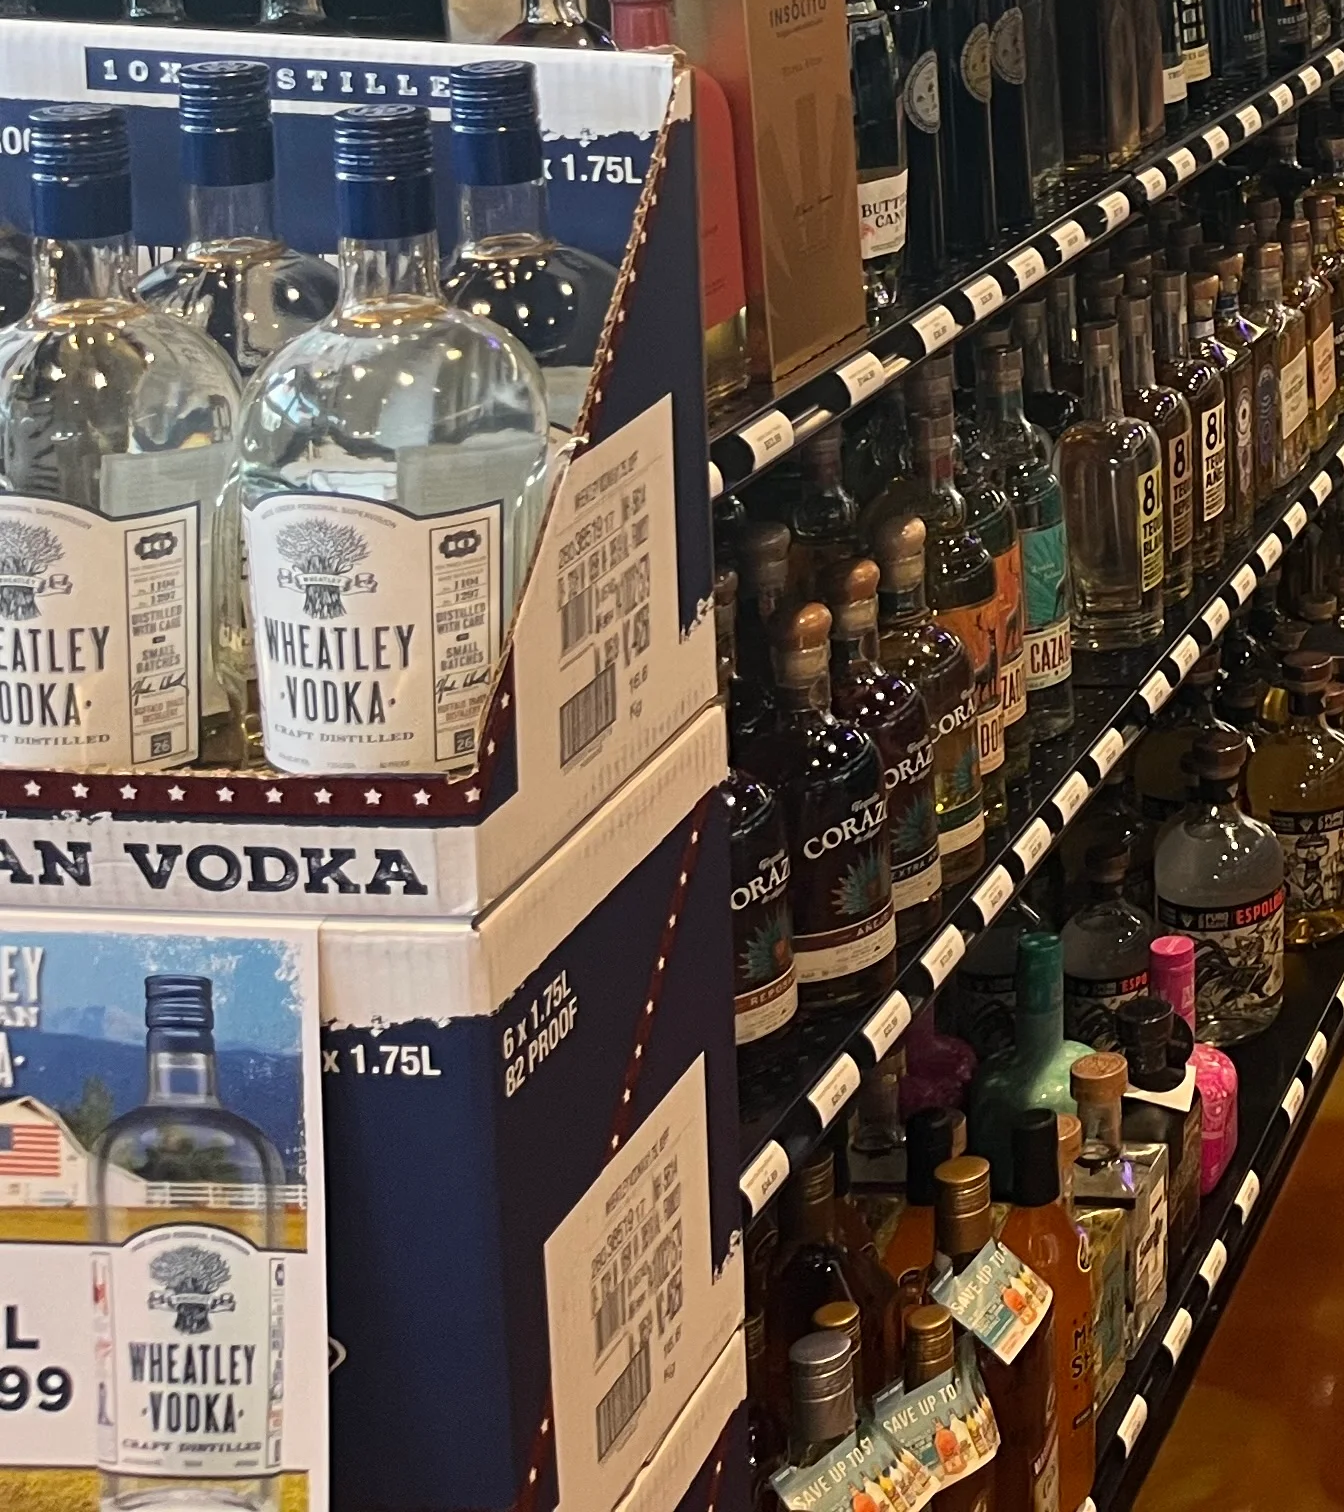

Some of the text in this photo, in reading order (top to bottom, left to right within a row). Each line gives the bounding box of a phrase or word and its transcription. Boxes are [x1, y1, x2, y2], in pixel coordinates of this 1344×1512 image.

[103, 59, 450, 98] 10X STILLE
[561, 153, 643, 184] 1.75L
[264, 616, 415, 671] WHEATLEY
[285, 675, 386, 724] VODKA
[153, 741, 170, 754] 26
[274, 723, 415, 744] CRAFT DISTILLED
[456, 738, 473, 751] 26
[123, 843, 429, 897] VODKA
[502, 970, 572, 1059] 6 x 1.75L
[350, 1044, 442, 1076] 1.75L
[504, 996, 578, 1098] 82 PROOF
[128, 1341, 257, 1386] WHEATLEY
[149, 1391, 237, 1434] VODKA
[883, 1405, 919, 1435] SAVE
[917, 1396, 937, 1416] UP
[829, 1460, 847, 1485] UP
